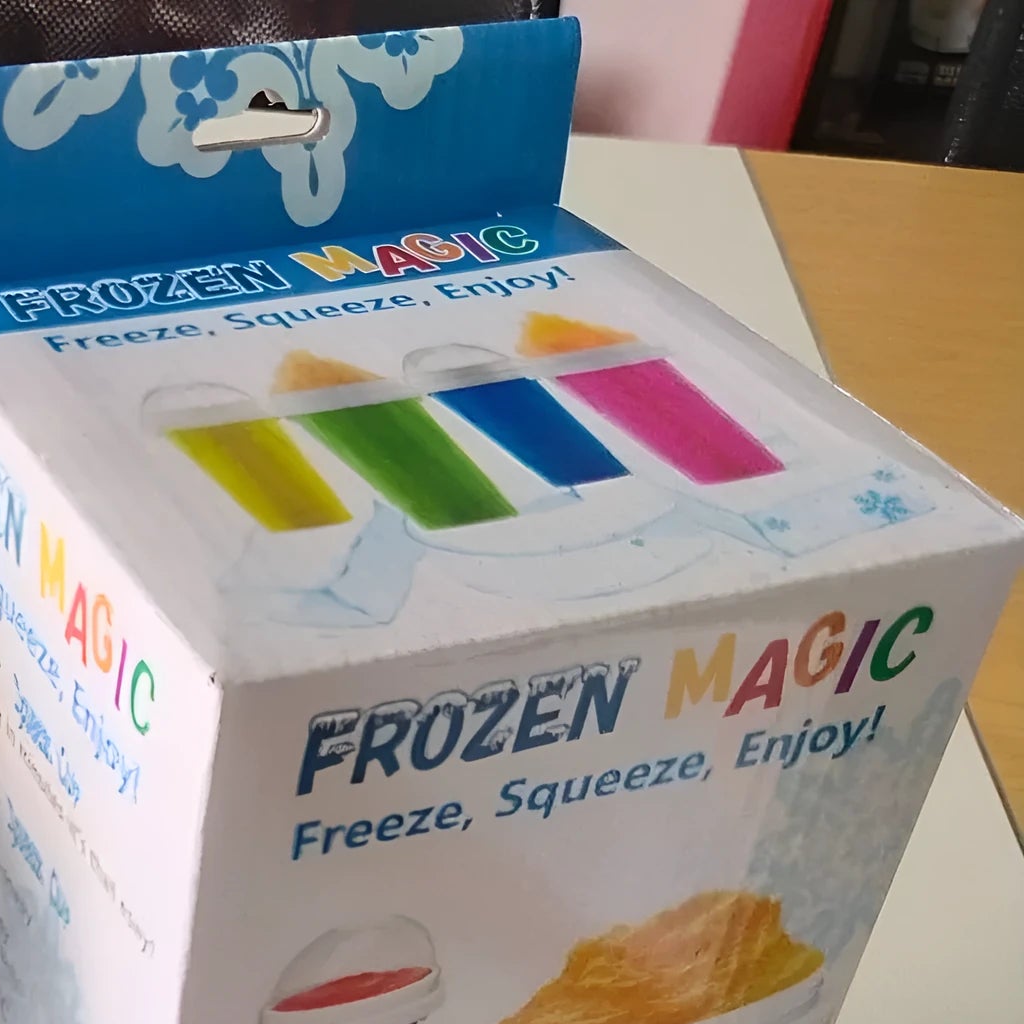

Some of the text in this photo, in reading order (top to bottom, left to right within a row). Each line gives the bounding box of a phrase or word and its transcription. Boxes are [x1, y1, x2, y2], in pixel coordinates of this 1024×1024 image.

[43, 265, 577, 354] Freeze, Squeeze, Enjoy!
[288, 224, 539, 282] MAGIC
[39, 519, 155, 736] MAGIC
[296, 605, 935, 797] FROZEN MAGIC
[291, 704, 887, 861] Freeze, Squeeze, Enjoy!
